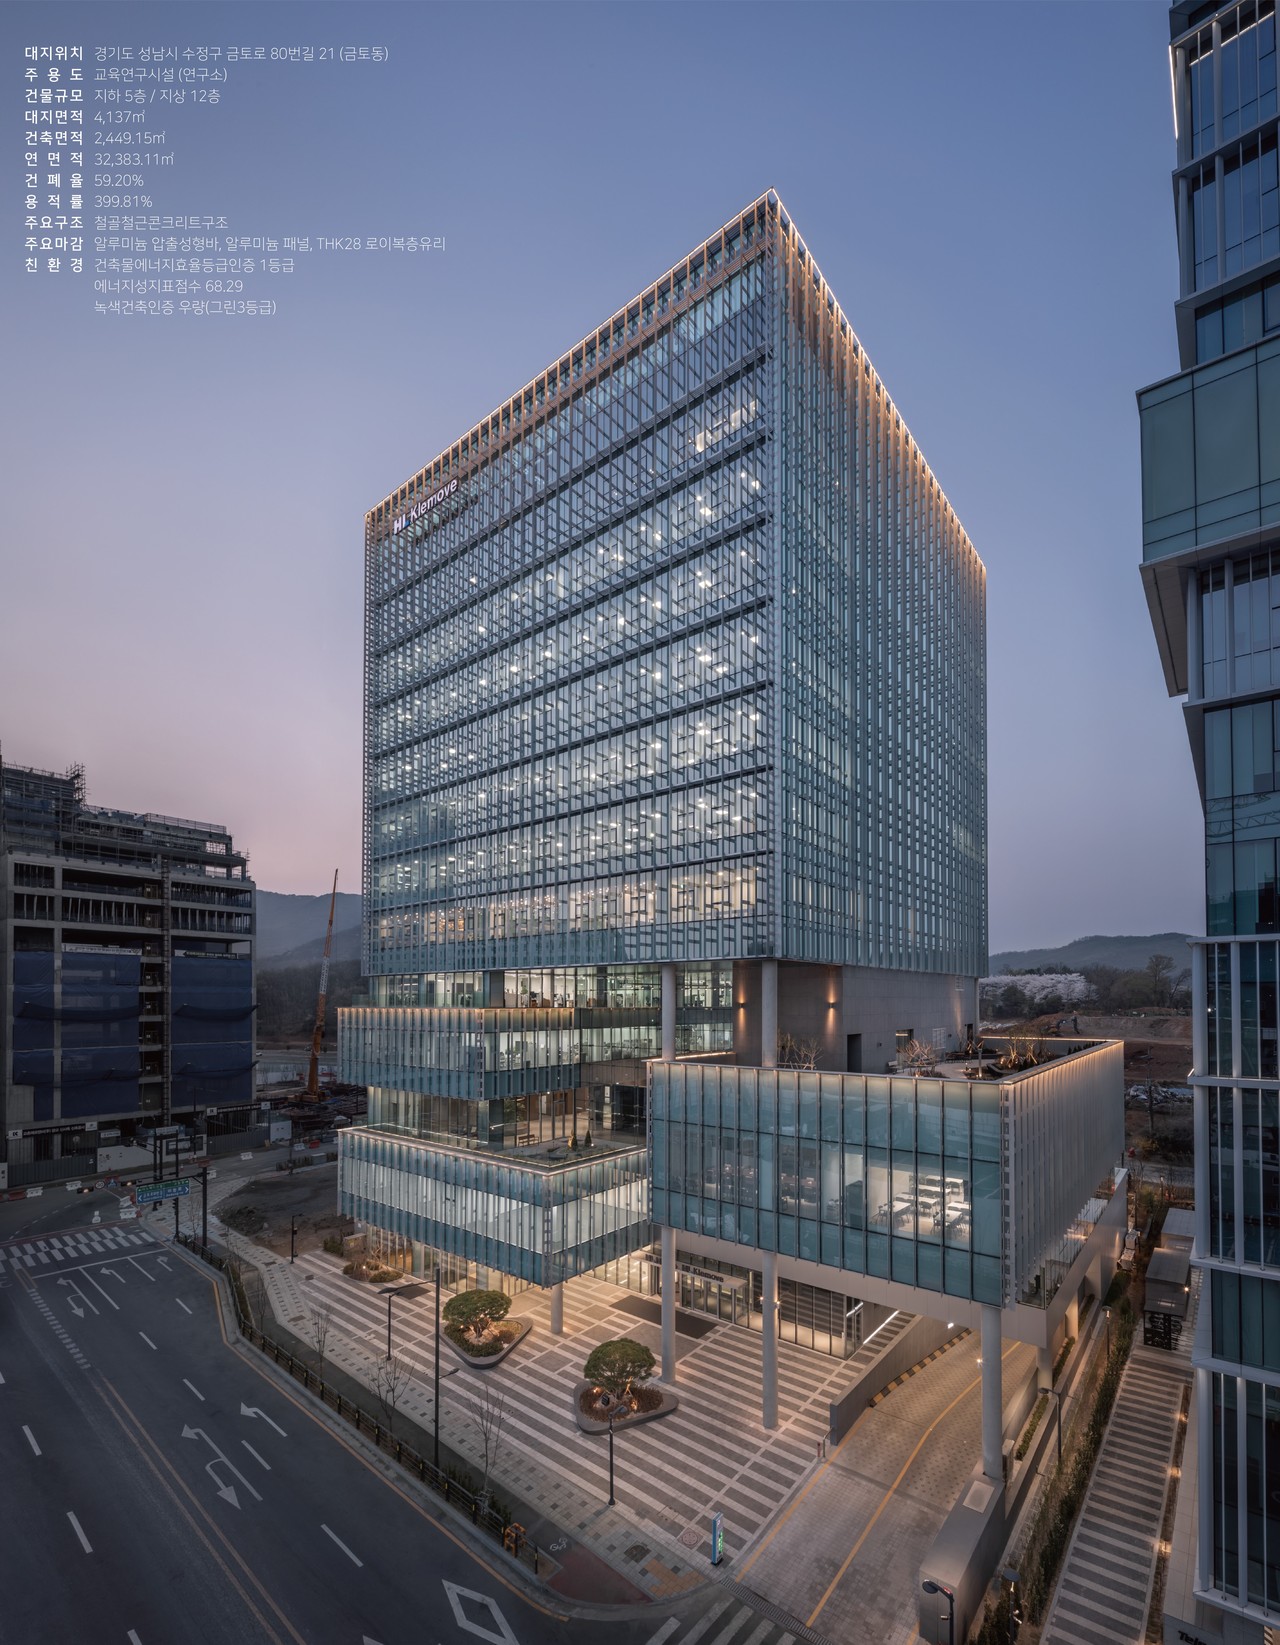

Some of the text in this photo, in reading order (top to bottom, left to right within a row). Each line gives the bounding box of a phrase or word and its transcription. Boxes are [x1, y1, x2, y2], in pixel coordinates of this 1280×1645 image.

[393, 479, 458, 534] HL Klemove
[693, 1266, 724, 1283] Klemove
